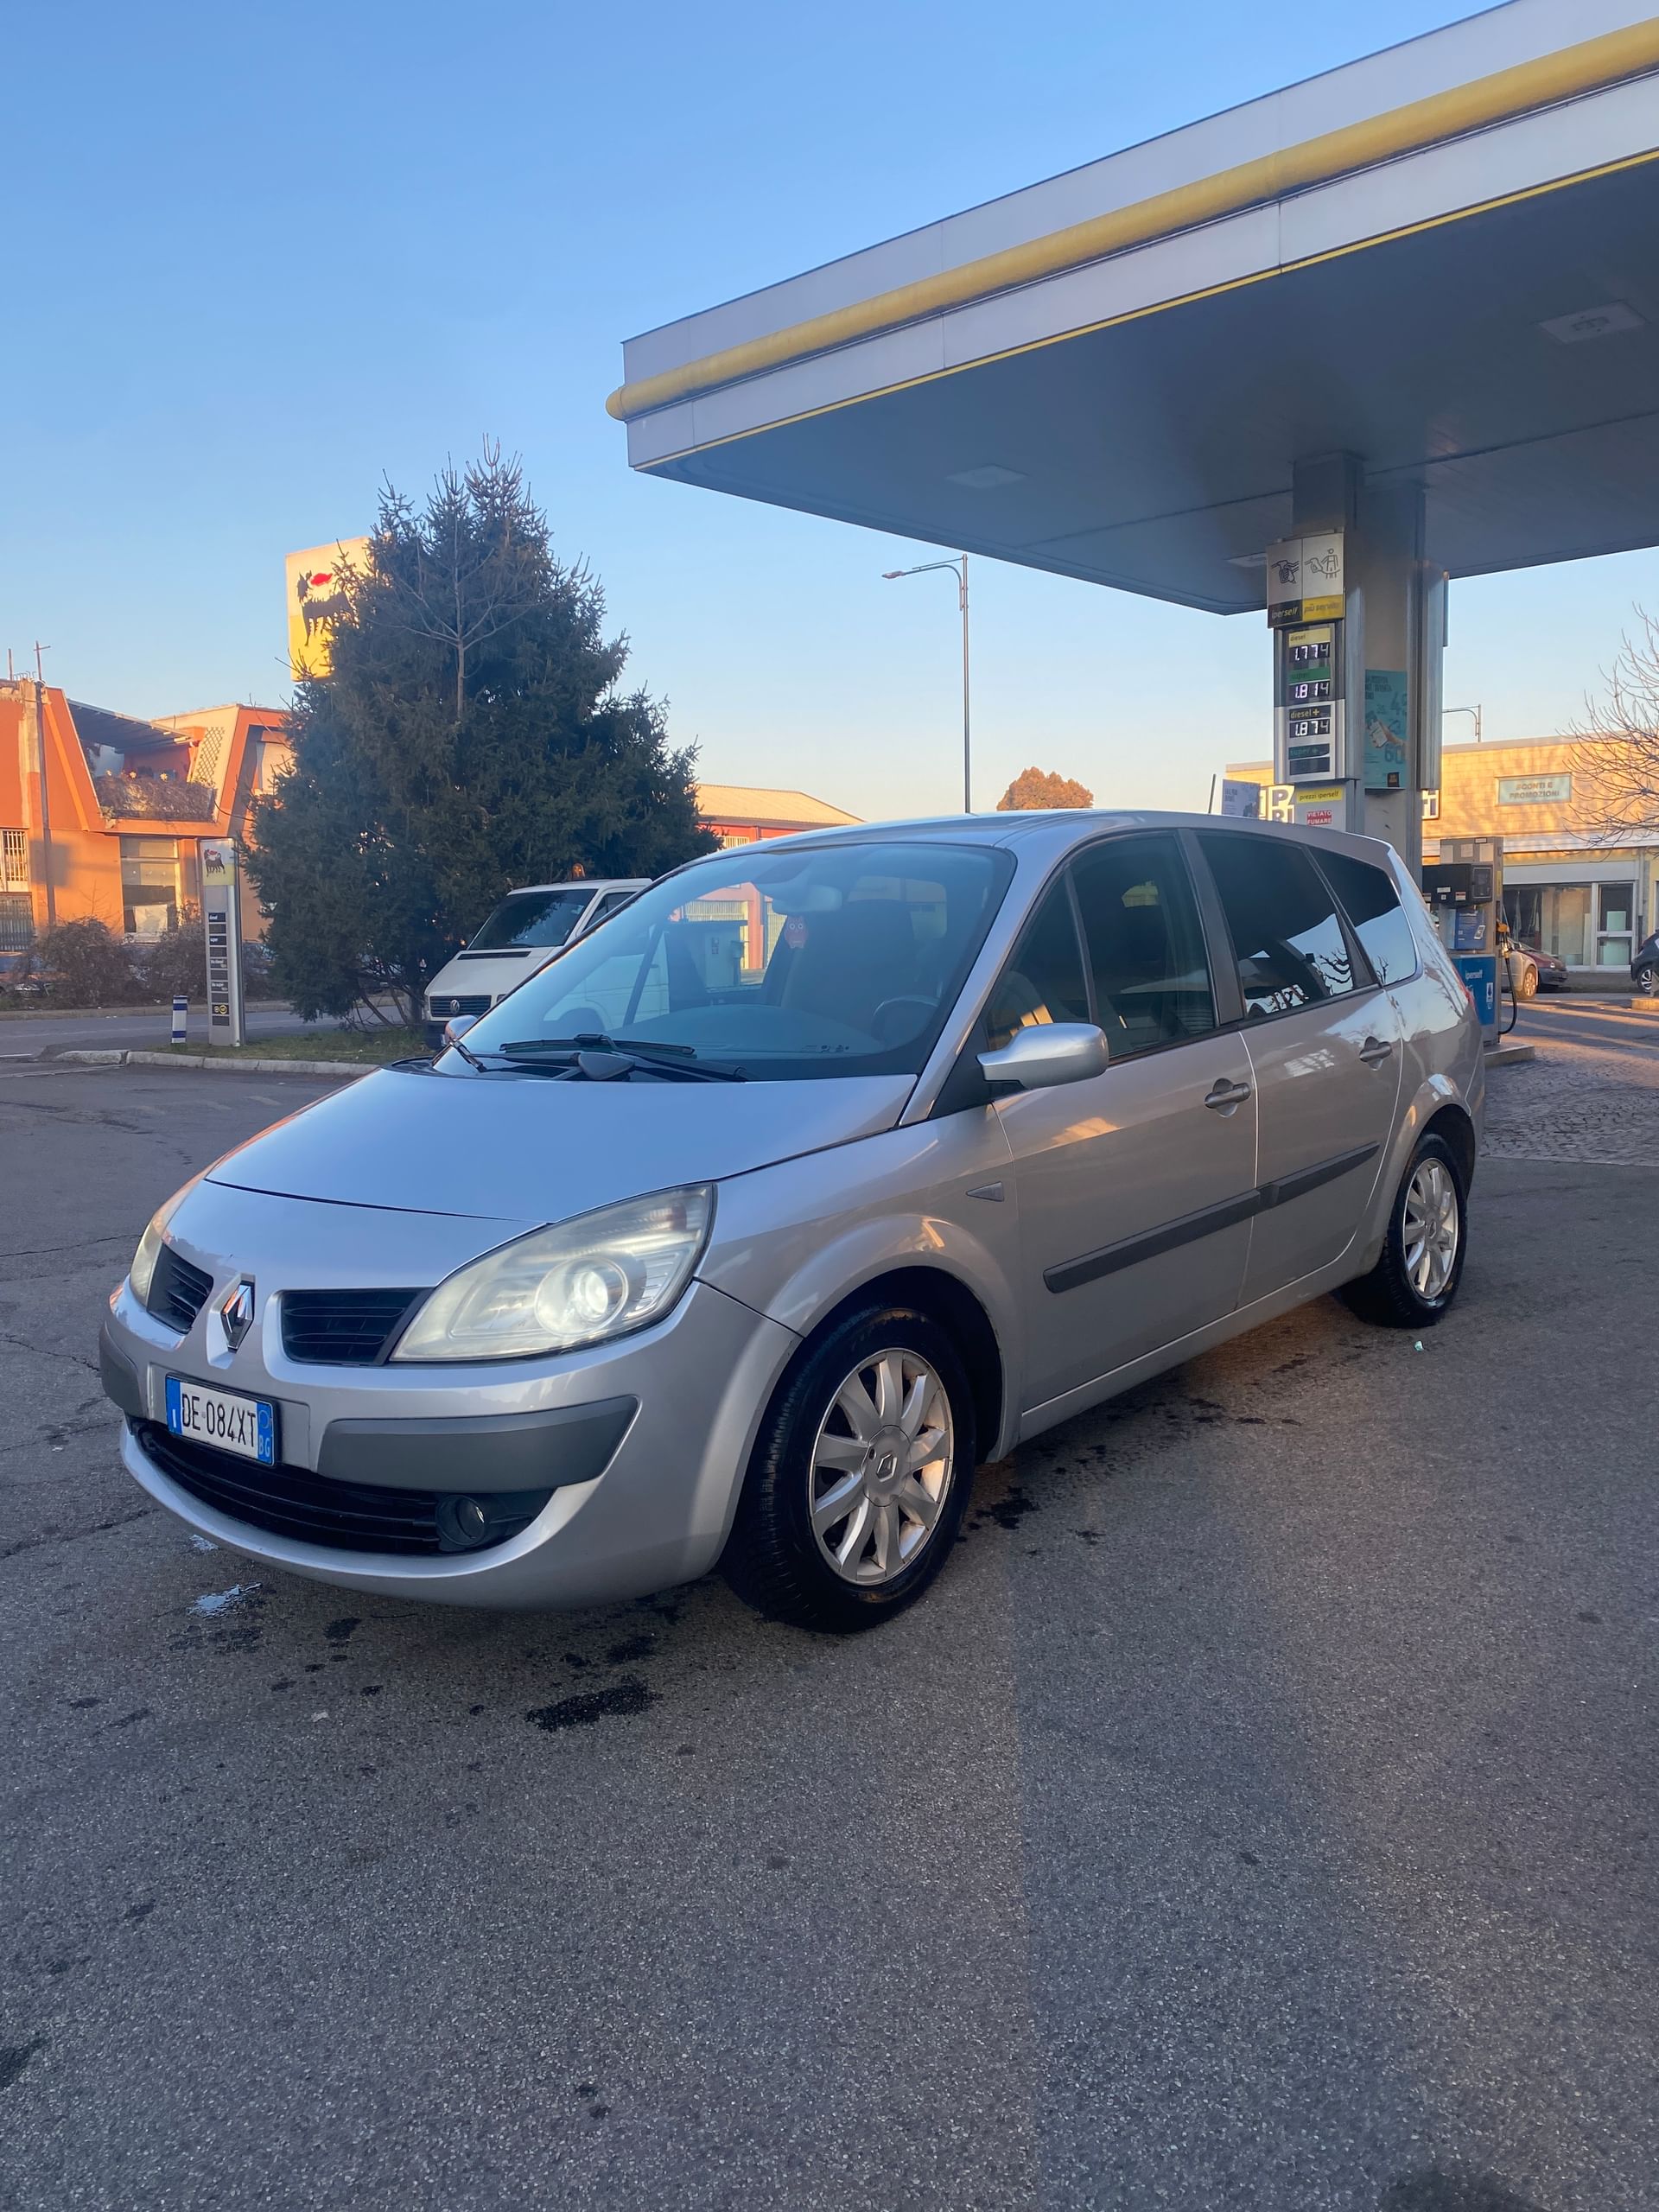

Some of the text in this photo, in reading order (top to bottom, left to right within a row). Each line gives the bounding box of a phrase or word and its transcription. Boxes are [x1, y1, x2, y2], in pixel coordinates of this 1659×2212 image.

[1290, 709, 1312, 719] diesel
[1516, 782, 1546, 791] SCONTI
[1299, 792, 1317, 801] prezzi
[1509, 790, 1560, 799] PROMOZIONI
[182, 1394, 256, 1447] DE 084XT
[258, 1434, 270, 1457] BG
